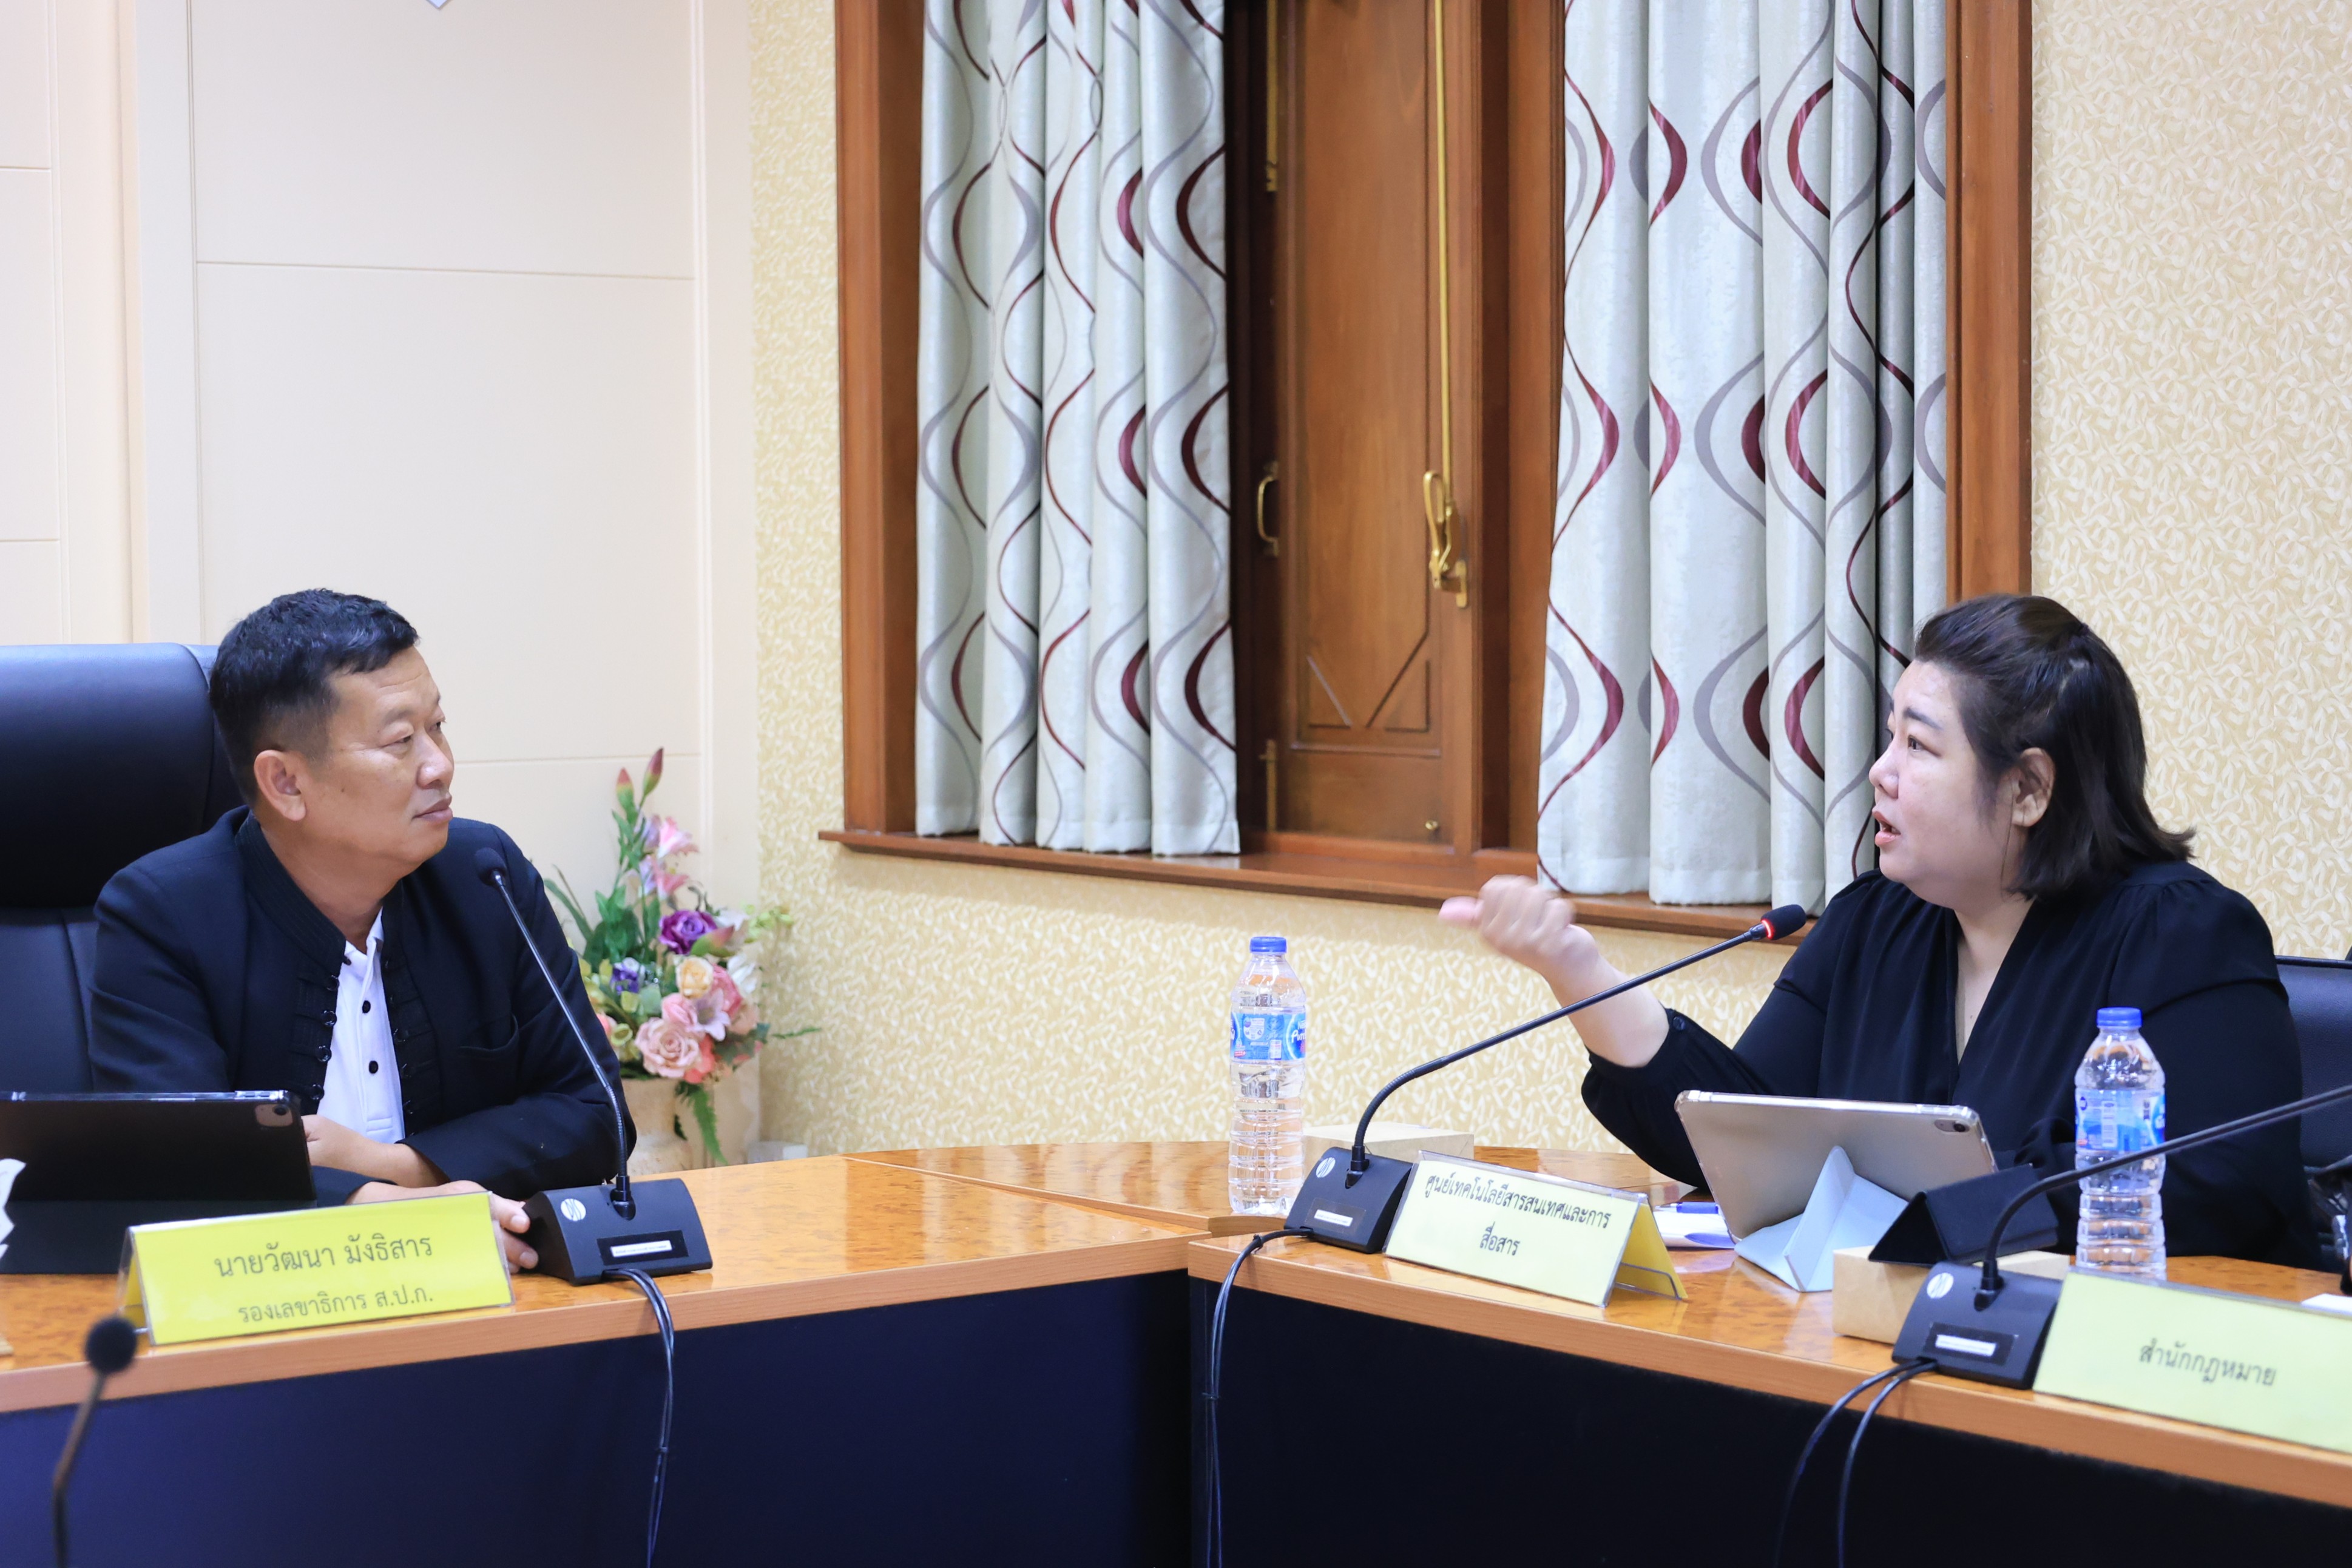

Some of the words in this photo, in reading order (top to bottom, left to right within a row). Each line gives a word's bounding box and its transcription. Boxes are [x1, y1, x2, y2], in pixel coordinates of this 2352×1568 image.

[1425, 1171, 1612, 1229] ศูนย์เทคโนโลยีสารสนเทศและการ
[214, 1242, 336, 1277] นายวัฒนา
[343, 1232, 433, 1265] มังธิสาร
[1479, 1221, 1521, 1256] สื่อสาร
[238, 1291, 367, 1323] รองเลขาธิการ
[374, 1284, 434, 1308] ส.ป.ก.
[2139, 1337, 2277, 1387] สำนักกฎหมาย
